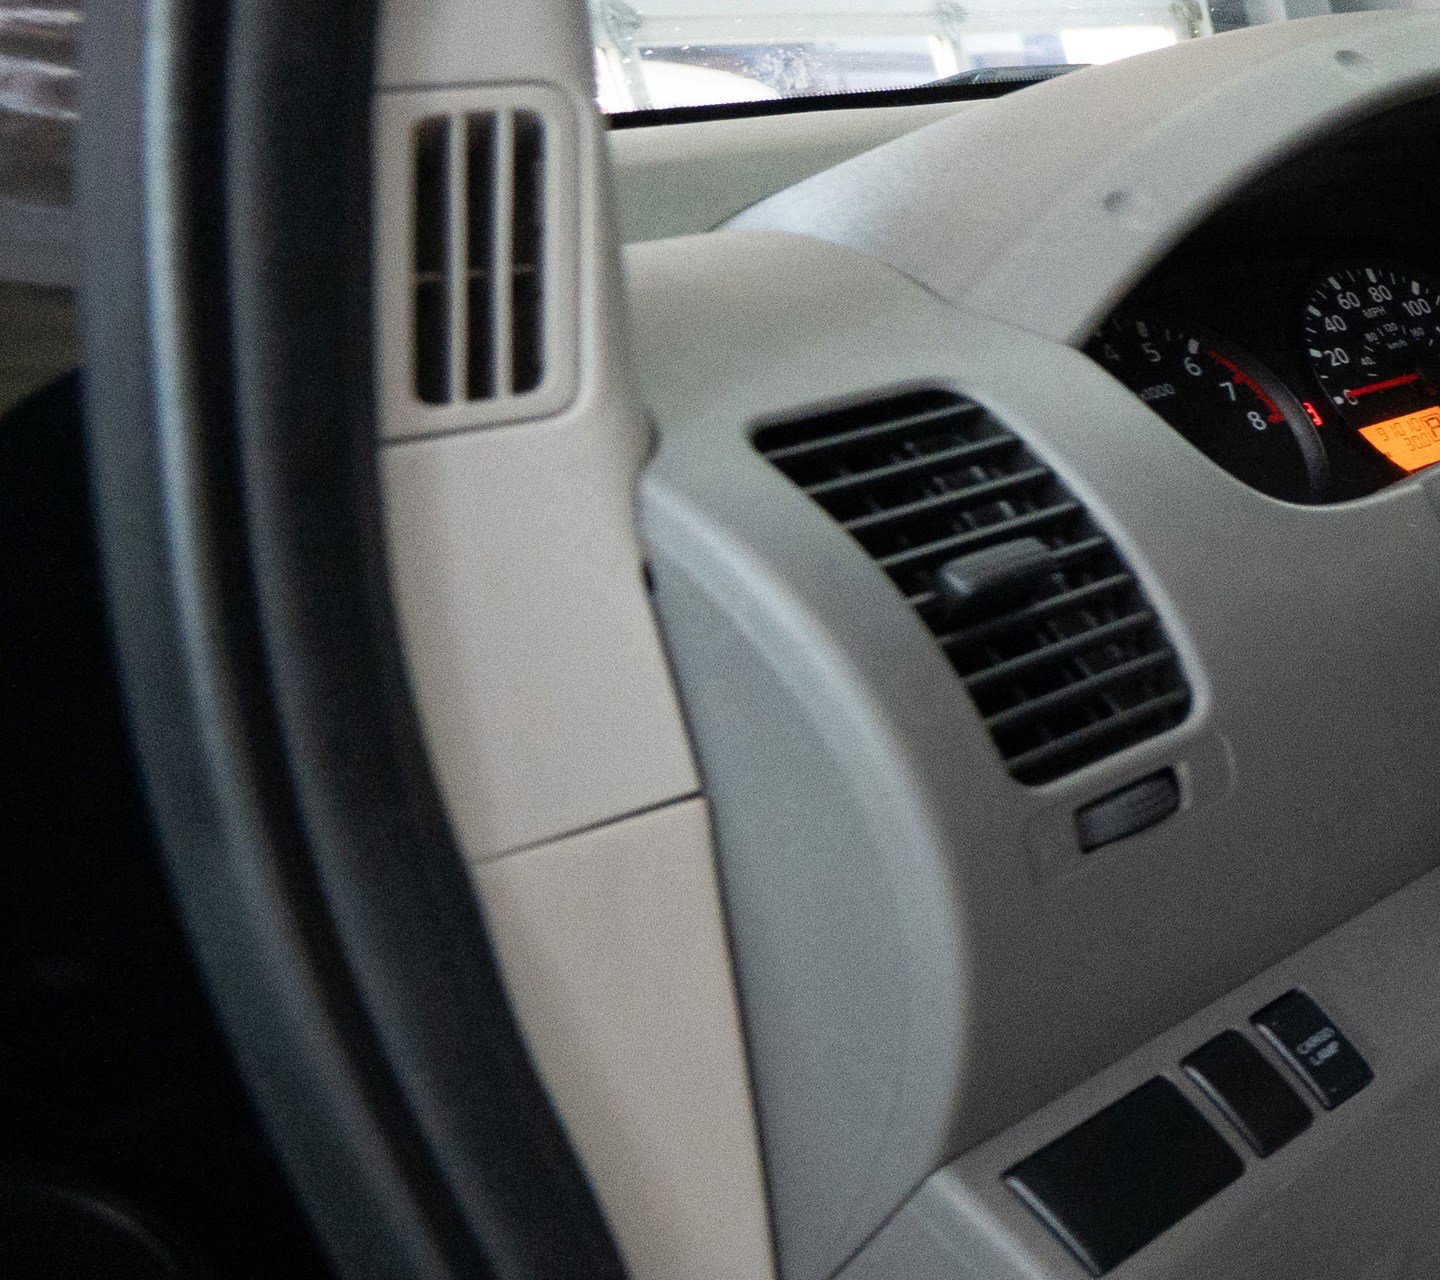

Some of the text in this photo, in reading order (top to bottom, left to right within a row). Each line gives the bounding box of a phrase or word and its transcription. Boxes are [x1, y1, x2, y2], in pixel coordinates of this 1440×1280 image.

[1337, 292, 1360, 309] 60
[1369, 286, 1392, 302] 80
[1403, 299, 1431, 317] 100
[1325, 316, 1347, 332] 40
[1324, 348, 1349, 366] 20
[1184, 357, 1201, 376] 6
[1219, 382, 1236, 401] 7
[1247, 411, 1267, 430] 8
